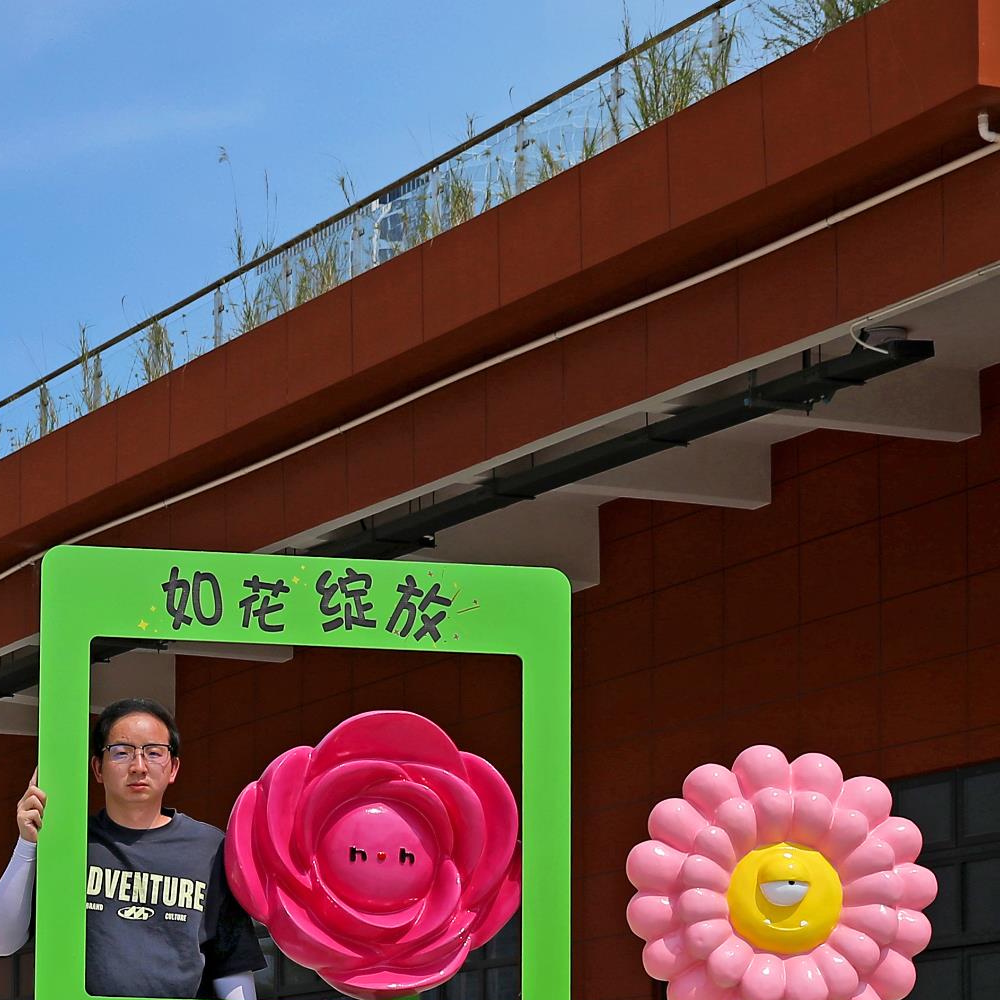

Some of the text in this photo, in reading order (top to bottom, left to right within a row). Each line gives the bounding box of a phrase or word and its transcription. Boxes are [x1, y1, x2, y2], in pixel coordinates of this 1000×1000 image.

[161, 566, 452, 642] 如花绽放
[86, 865, 207, 912] DVENTURE
[164, 912, 188, 922] CULTURE
